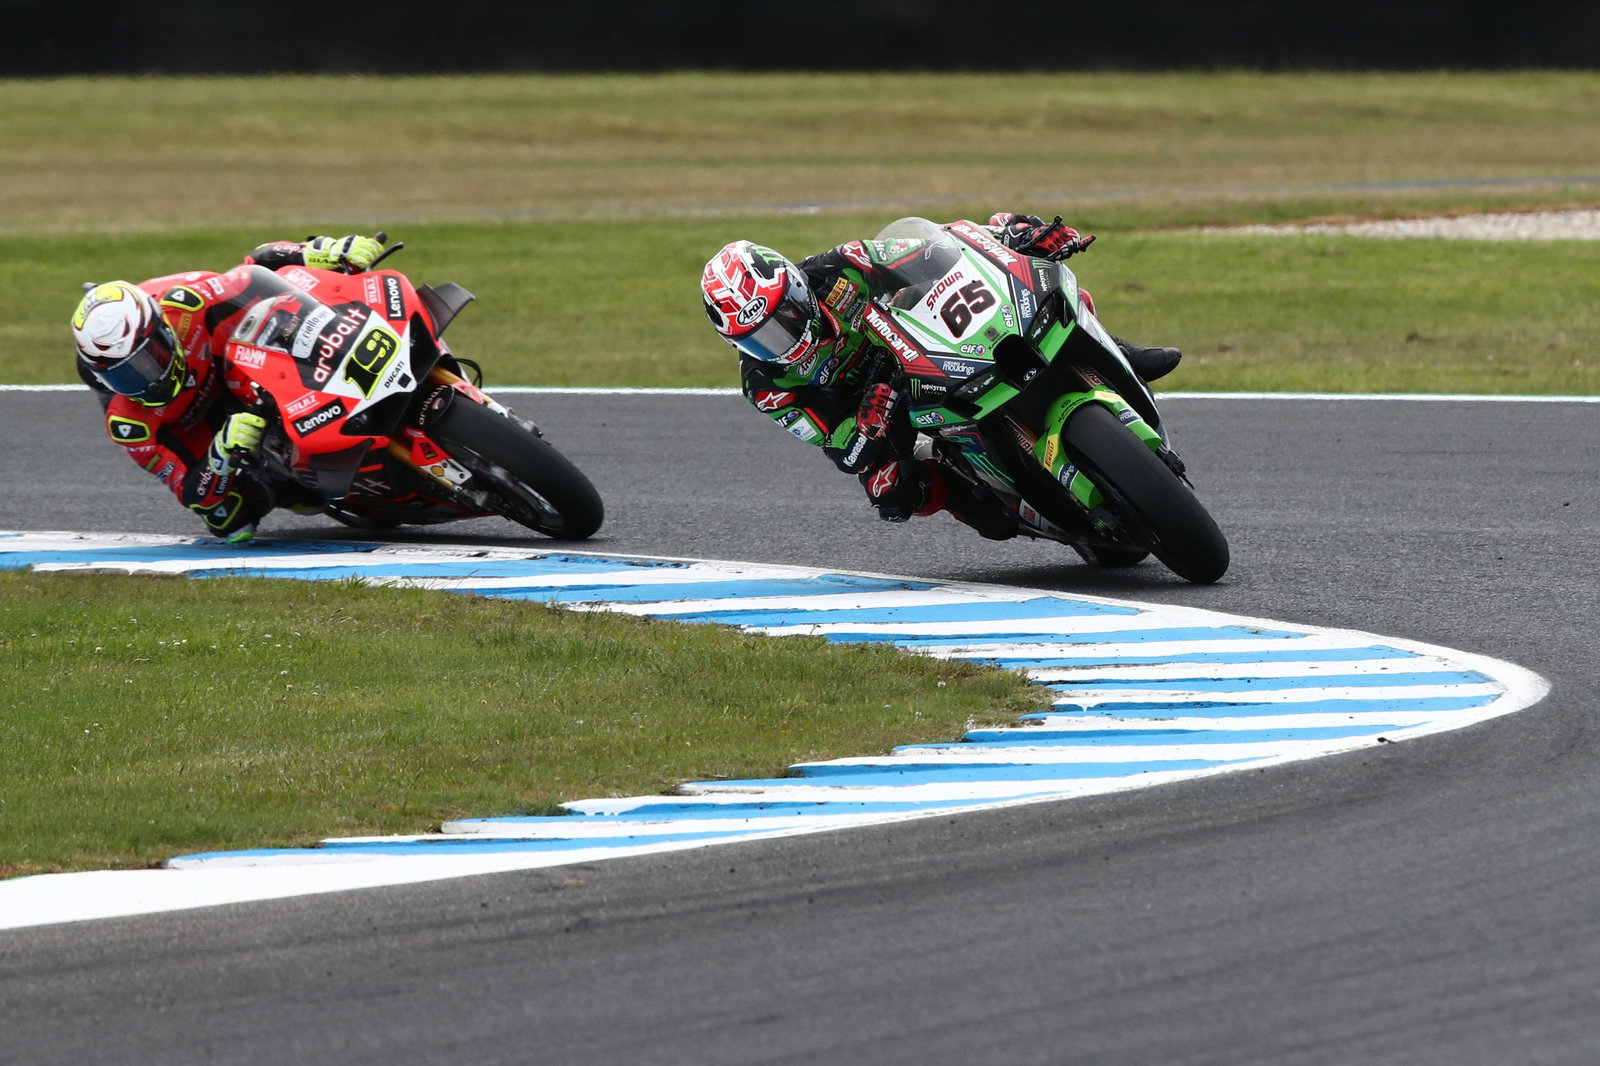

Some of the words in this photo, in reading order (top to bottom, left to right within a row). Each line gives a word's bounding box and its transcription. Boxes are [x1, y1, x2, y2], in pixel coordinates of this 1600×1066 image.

[387, 277, 402, 318] Lenovo
[926, 271, 963, 311] SHOWA
[741, 299, 763, 324] Arai
[853, 302, 867, 330] SHOWA
[940, 280, 997, 338] 65
[1003, 313, 1014, 328] elf
[234, 345, 267, 366] FIAMM
[342, 326, 401, 400] 19
[960, 344, 977, 358] elf
[384, 360, 405, 388] DUCATI
[820, 365, 831, 384] elf
[921, 384, 947, 392] MONSTER
[296, 405, 342, 433] Lenovo
[916, 414, 934, 425] elf
